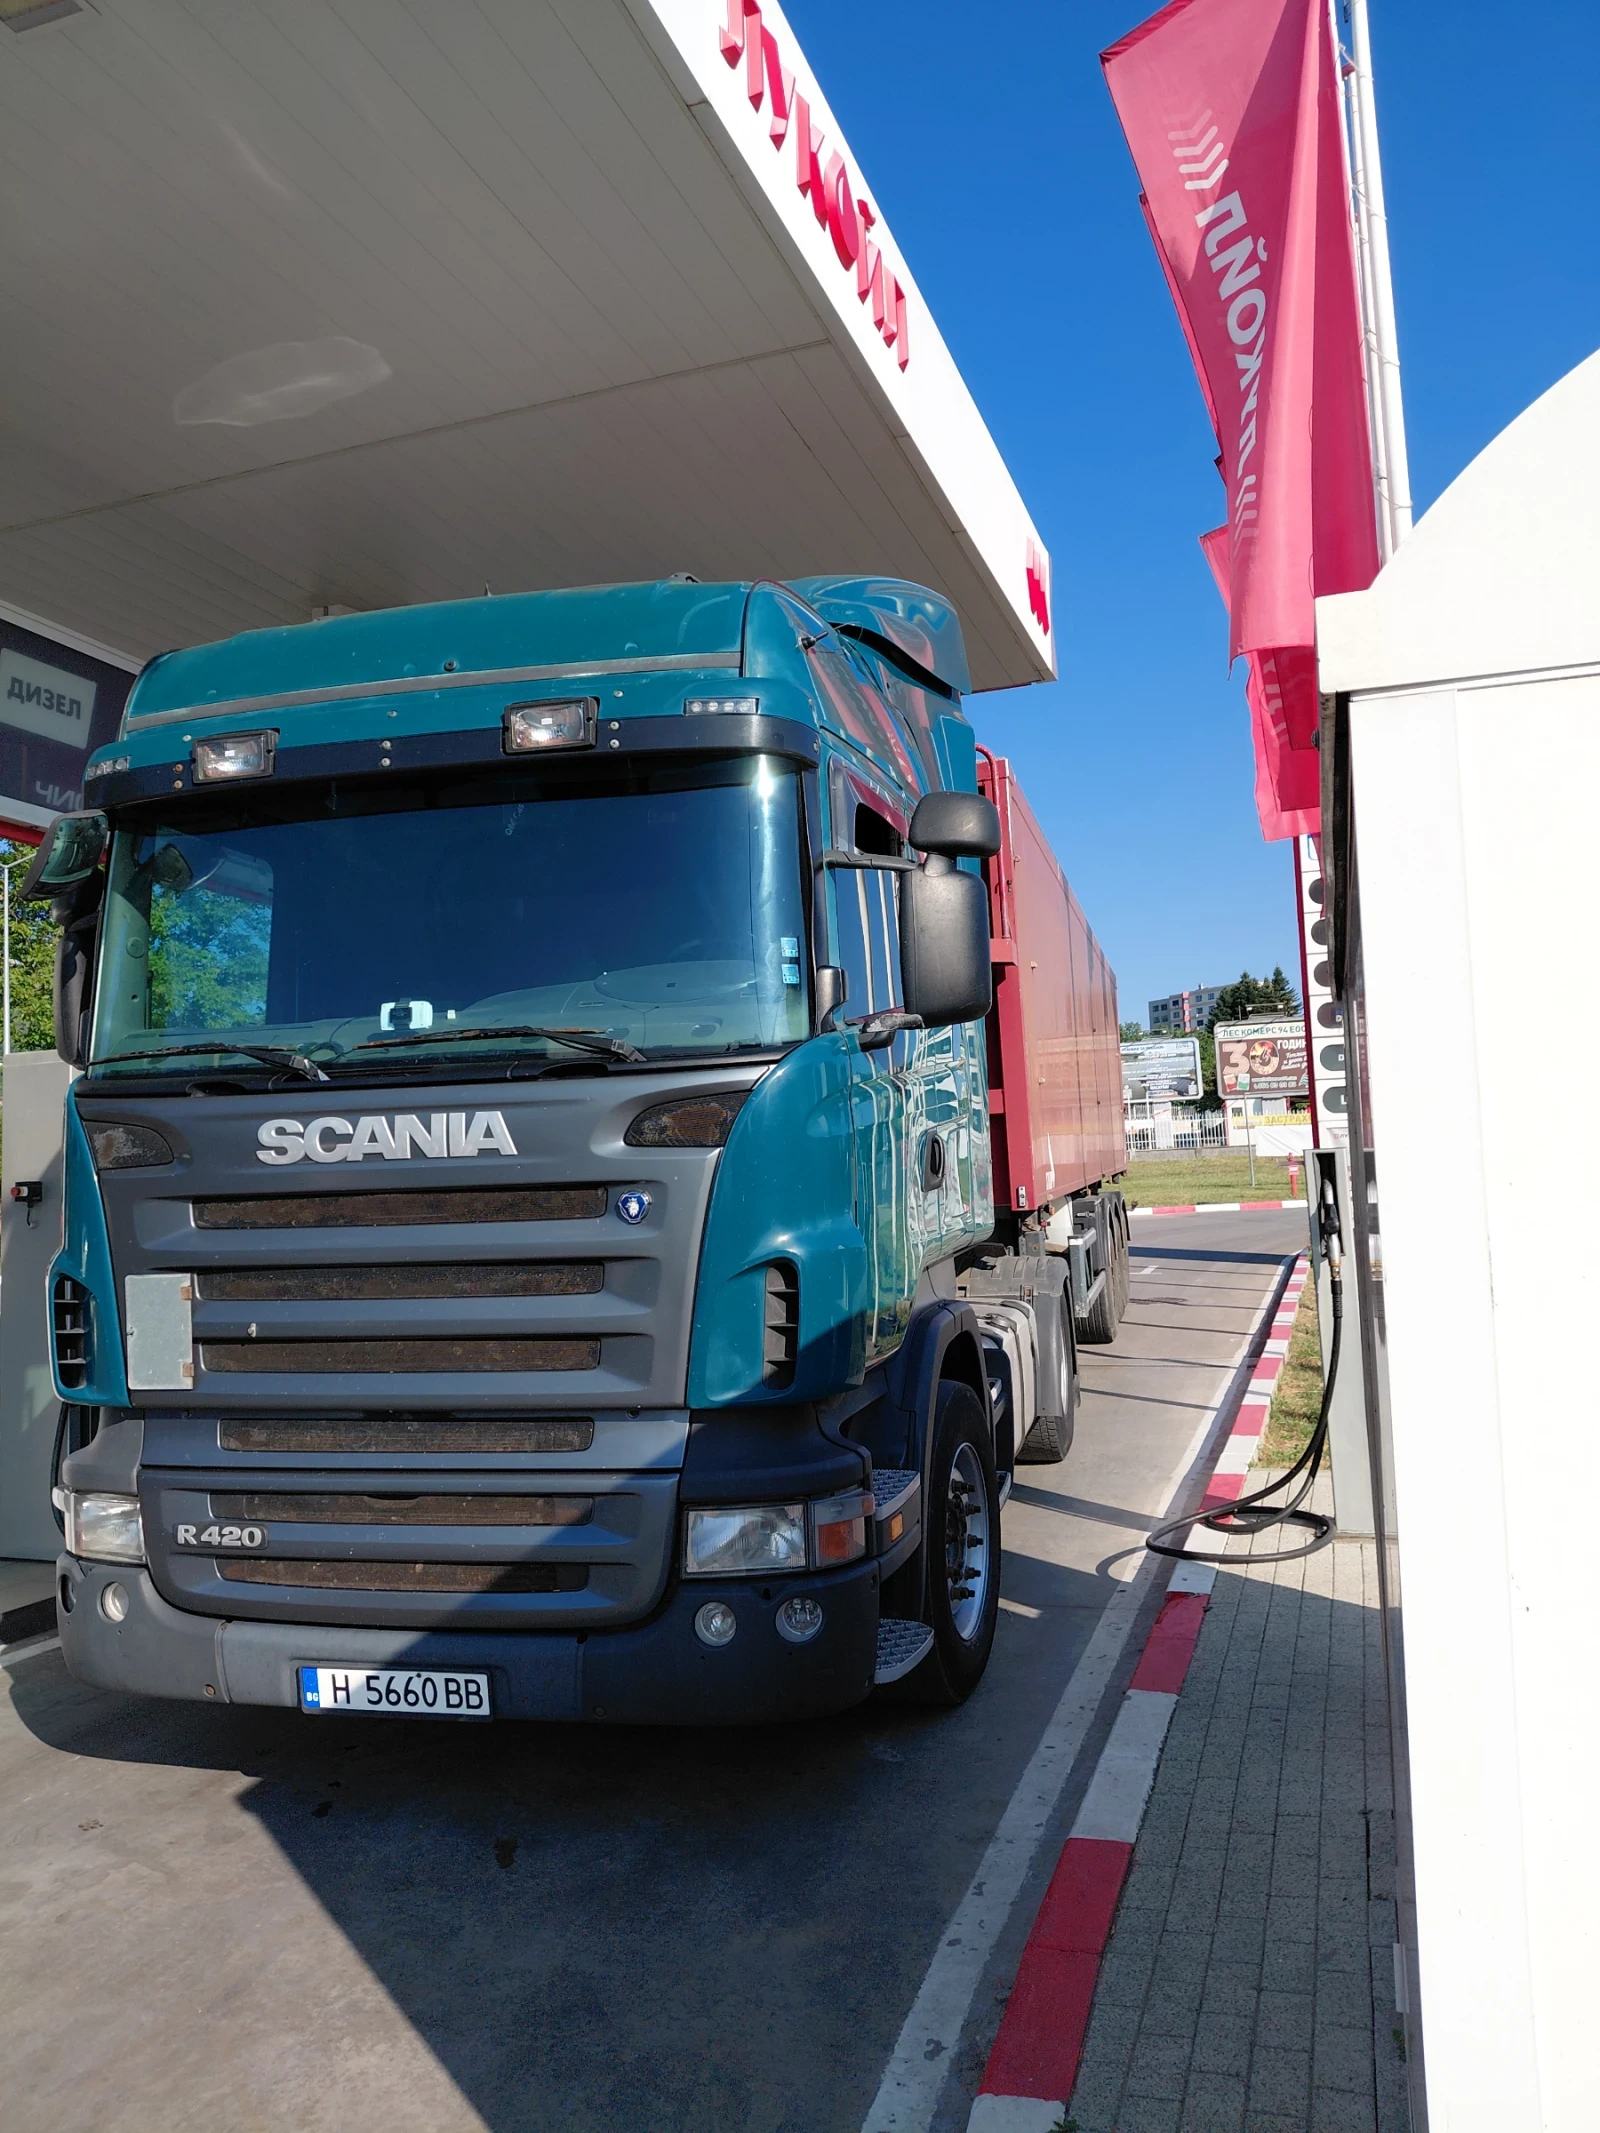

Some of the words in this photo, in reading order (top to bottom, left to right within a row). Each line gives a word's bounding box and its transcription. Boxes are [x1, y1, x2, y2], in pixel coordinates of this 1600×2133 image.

[7, 676, 82, 720] ДИЗЕЛ
[1241, 1026, 1277, 1036] КОМЕРС
[1278, 1026, 1288, 1034] 94
[1265, 1115, 1311, 1124] ЗАСТРАХ
[255, 1111, 518, 1165] SCANIA
[306, 1691, 319, 1702] BG
[331, 1673, 351, 1704] H
